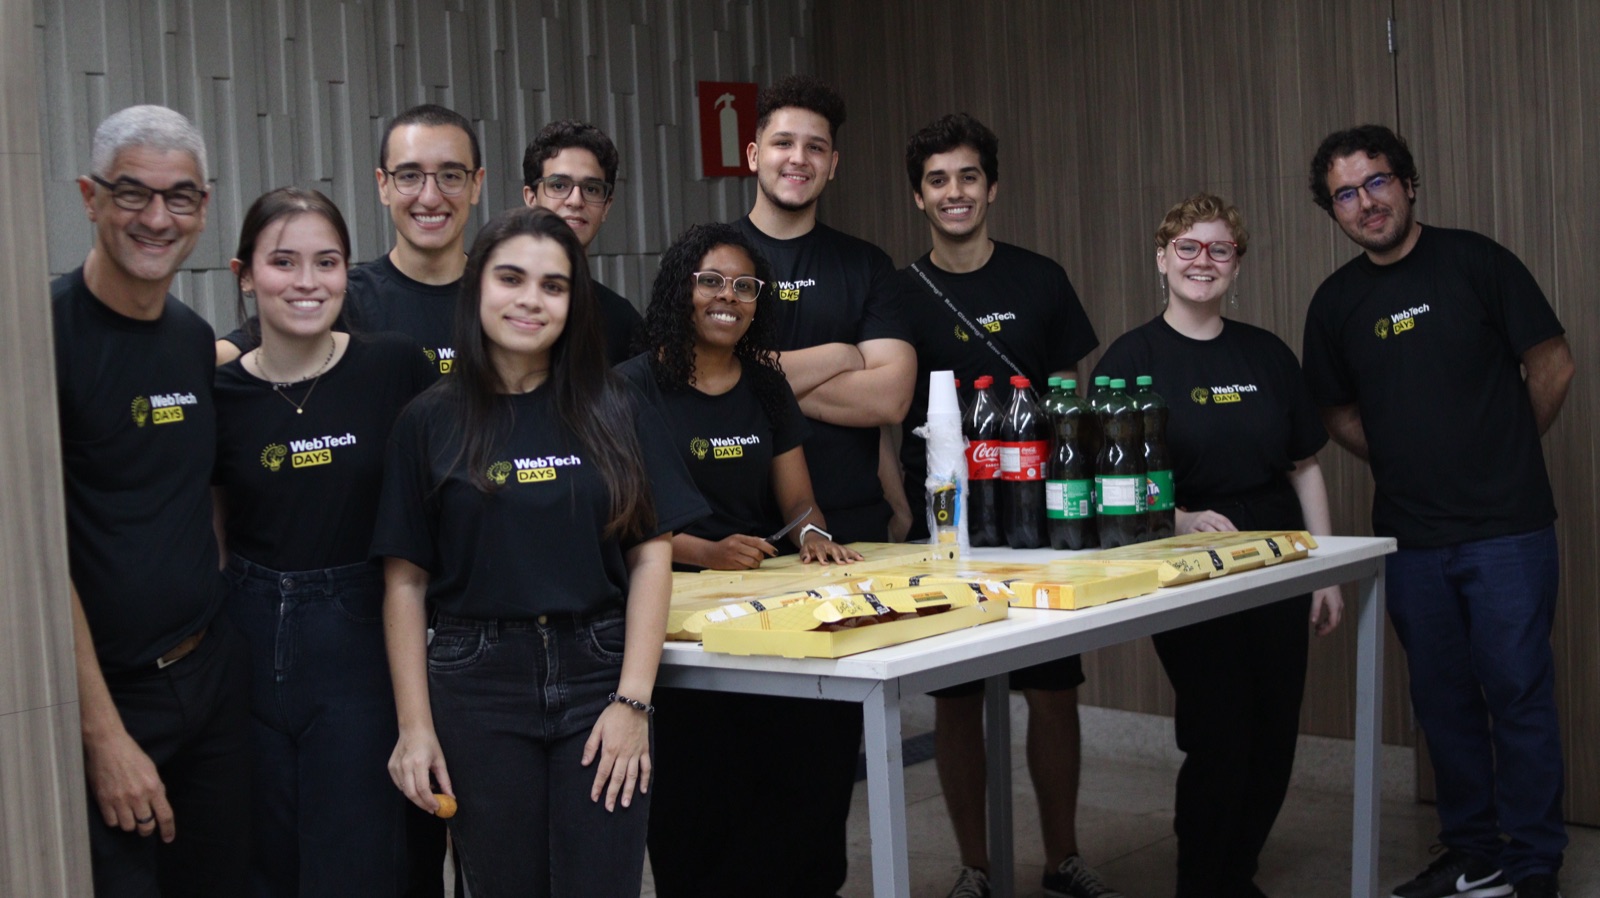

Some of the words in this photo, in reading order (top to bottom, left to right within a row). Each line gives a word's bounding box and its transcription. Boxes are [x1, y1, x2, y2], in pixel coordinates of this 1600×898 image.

[1390, 303, 1430, 324] WebTech
[987, 322, 1000, 331] YS
[1394, 318, 1414, 333] DAYS
[1211, 384, 1257, 395] WebTech
[150, 392, 198, 408] WebTech
[1214, 394, 1240, 402] DAYS
[153, 408, 182, 422] DAYS
[290, 432, 356, 453] WebTech
[709, 434, 760, 447] WebTech
[294, 452, 330, 466] DAYS
[715, 447, 742, 457] DAYS
[514, 455, 581, 469] WebTech
[519, 468, 556, 481] DAYS
